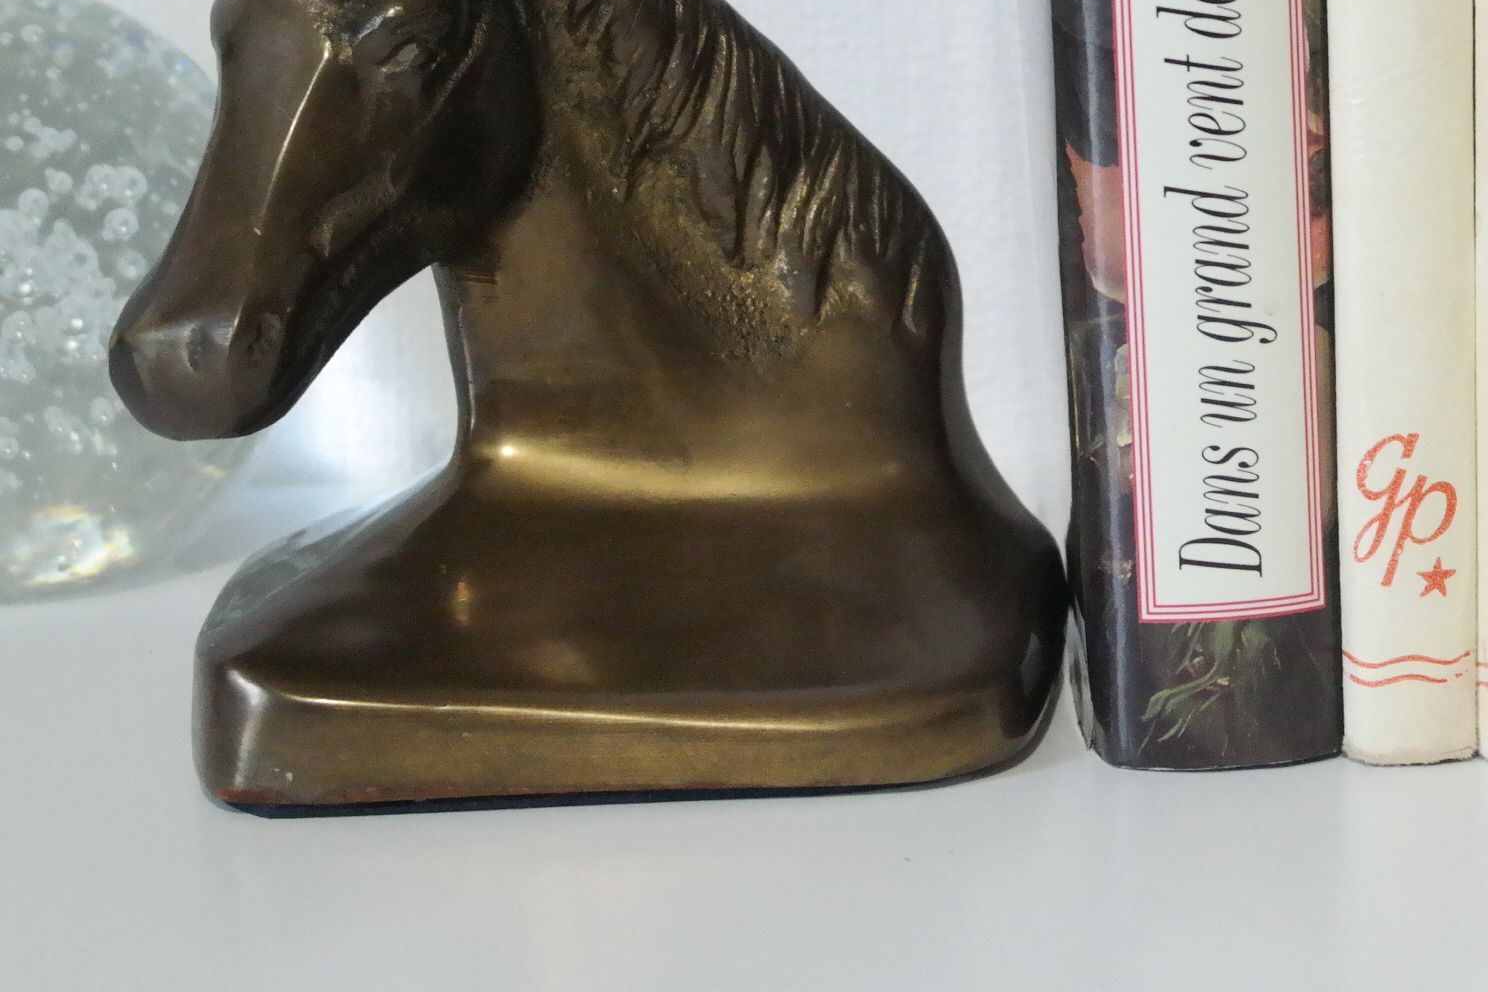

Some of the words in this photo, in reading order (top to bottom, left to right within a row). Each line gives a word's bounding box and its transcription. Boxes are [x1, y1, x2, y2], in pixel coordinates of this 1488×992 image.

[1164, 54, 1248, 170] vent
[1163, 185, 1278, 344] grand
[1198, 360, 1257, 428] un
[1179, 445, 1262, 578] Dans
